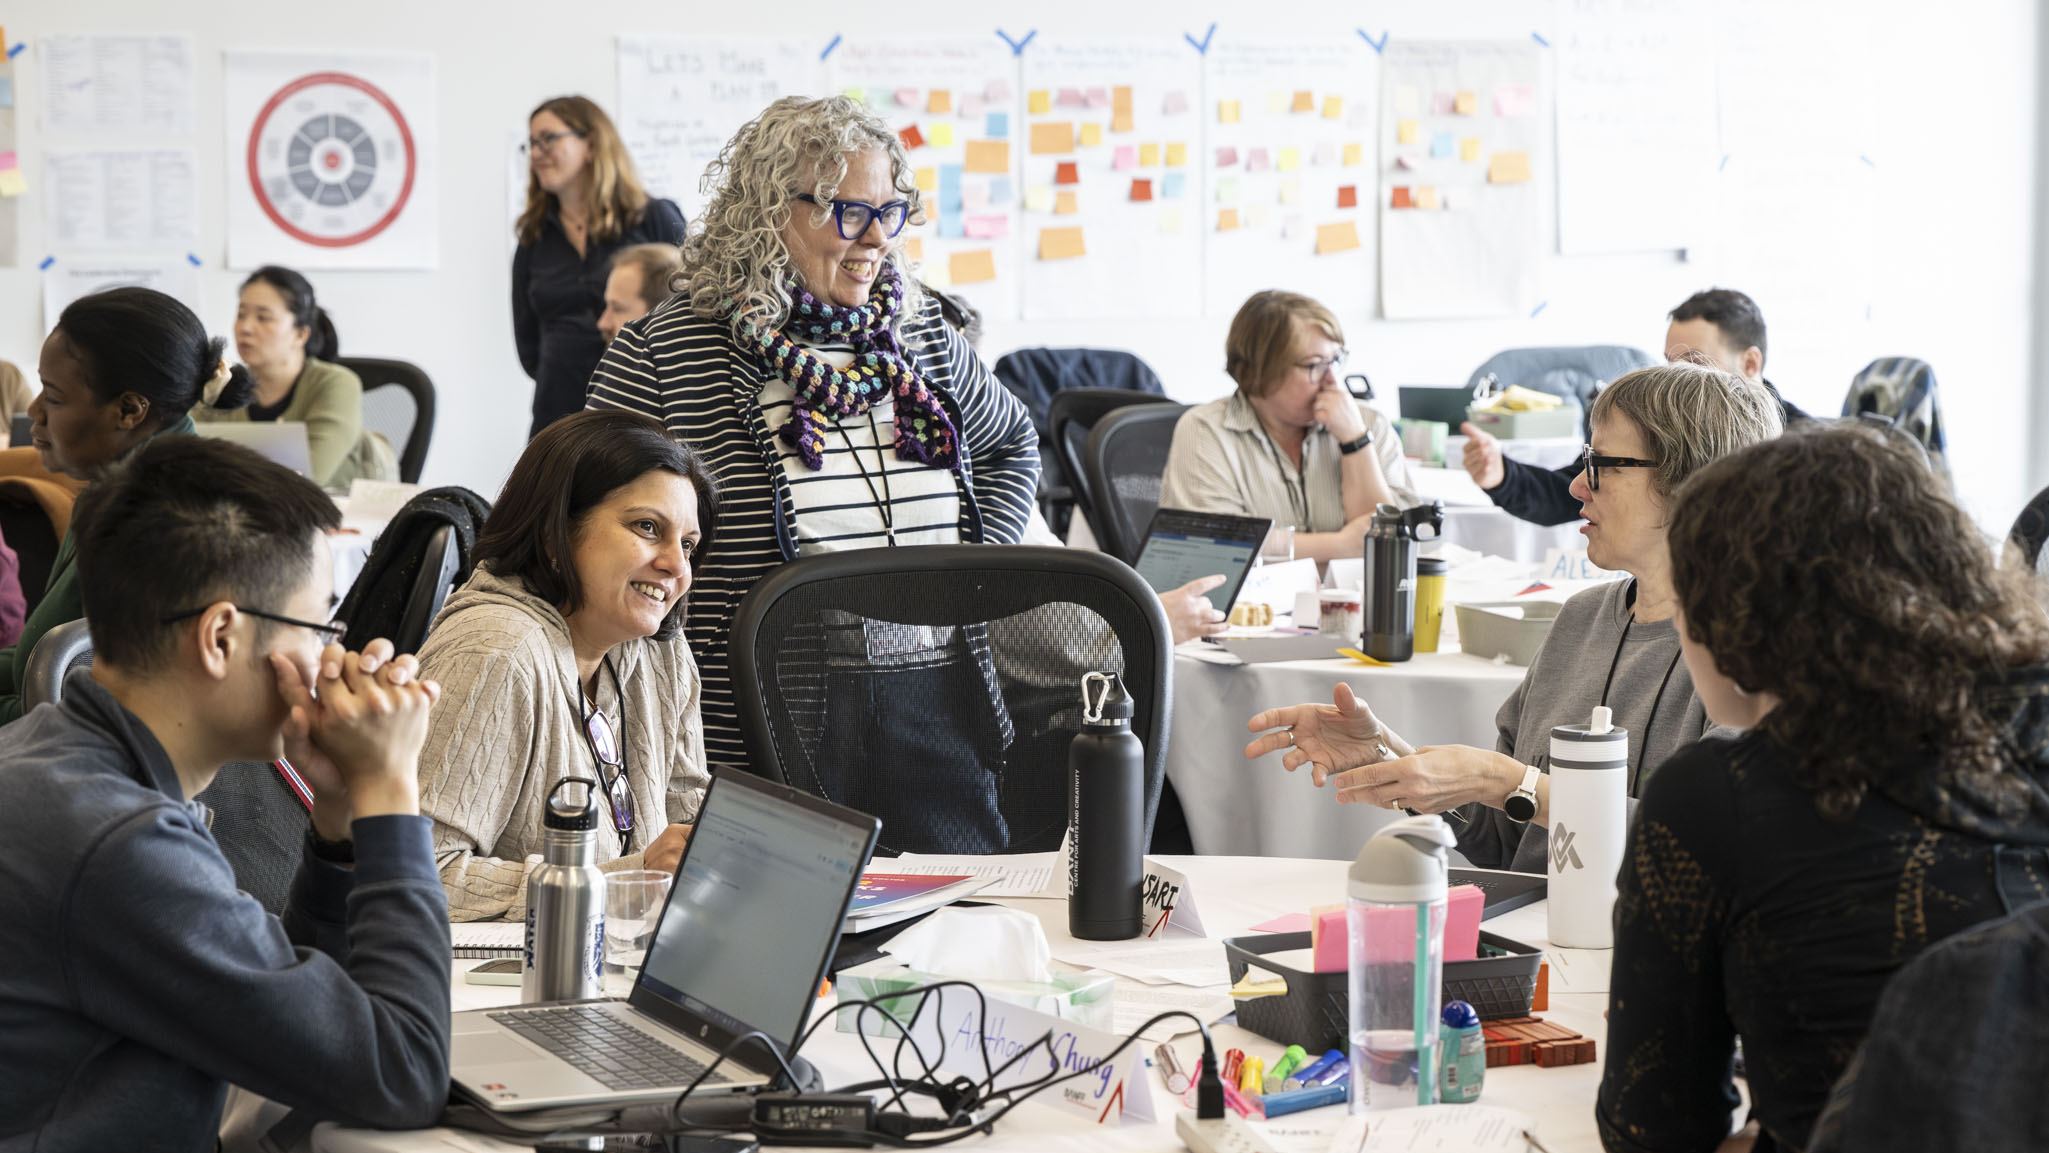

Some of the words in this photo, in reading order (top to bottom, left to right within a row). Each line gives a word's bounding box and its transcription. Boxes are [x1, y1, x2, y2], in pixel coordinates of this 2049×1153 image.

[1143, 873, 1179, 911] SARI
[951, 1011, 1034, 1076] Anthony
[1050, 1032, 1113, 1099] Chung
